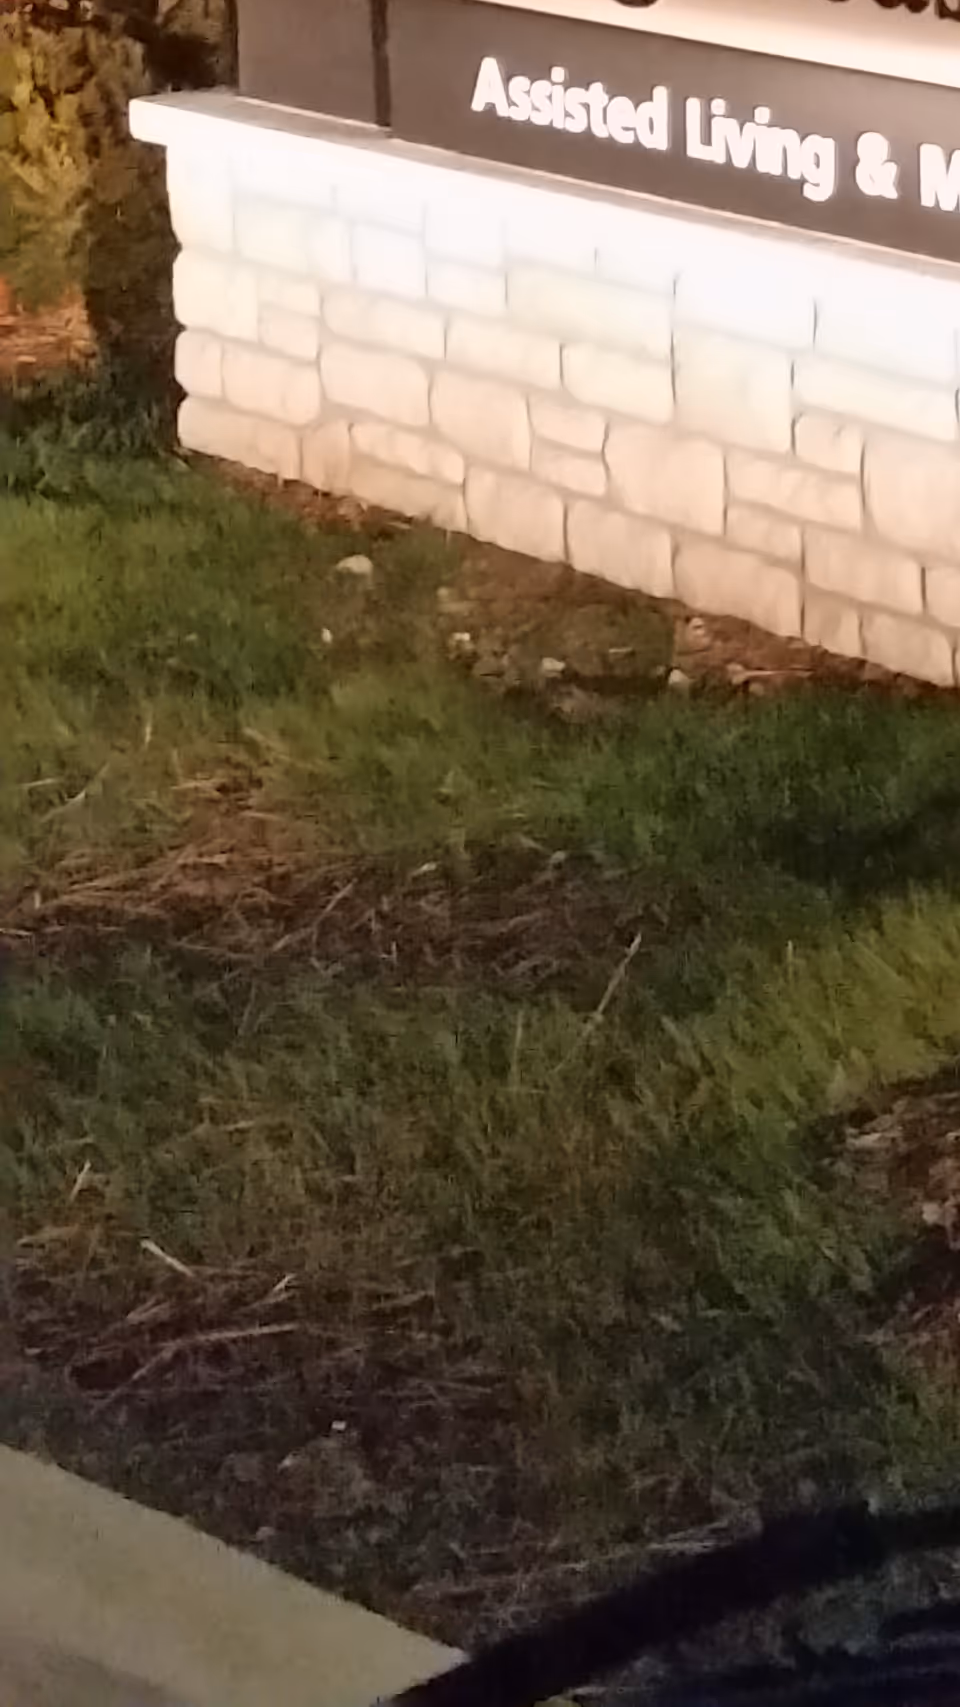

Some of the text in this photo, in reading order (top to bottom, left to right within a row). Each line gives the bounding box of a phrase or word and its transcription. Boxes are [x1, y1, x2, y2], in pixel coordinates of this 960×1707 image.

[471, 56, 669, 151] Assisted
[686, 97, 836, 202] Living
[855, 131, 898, 199] &
